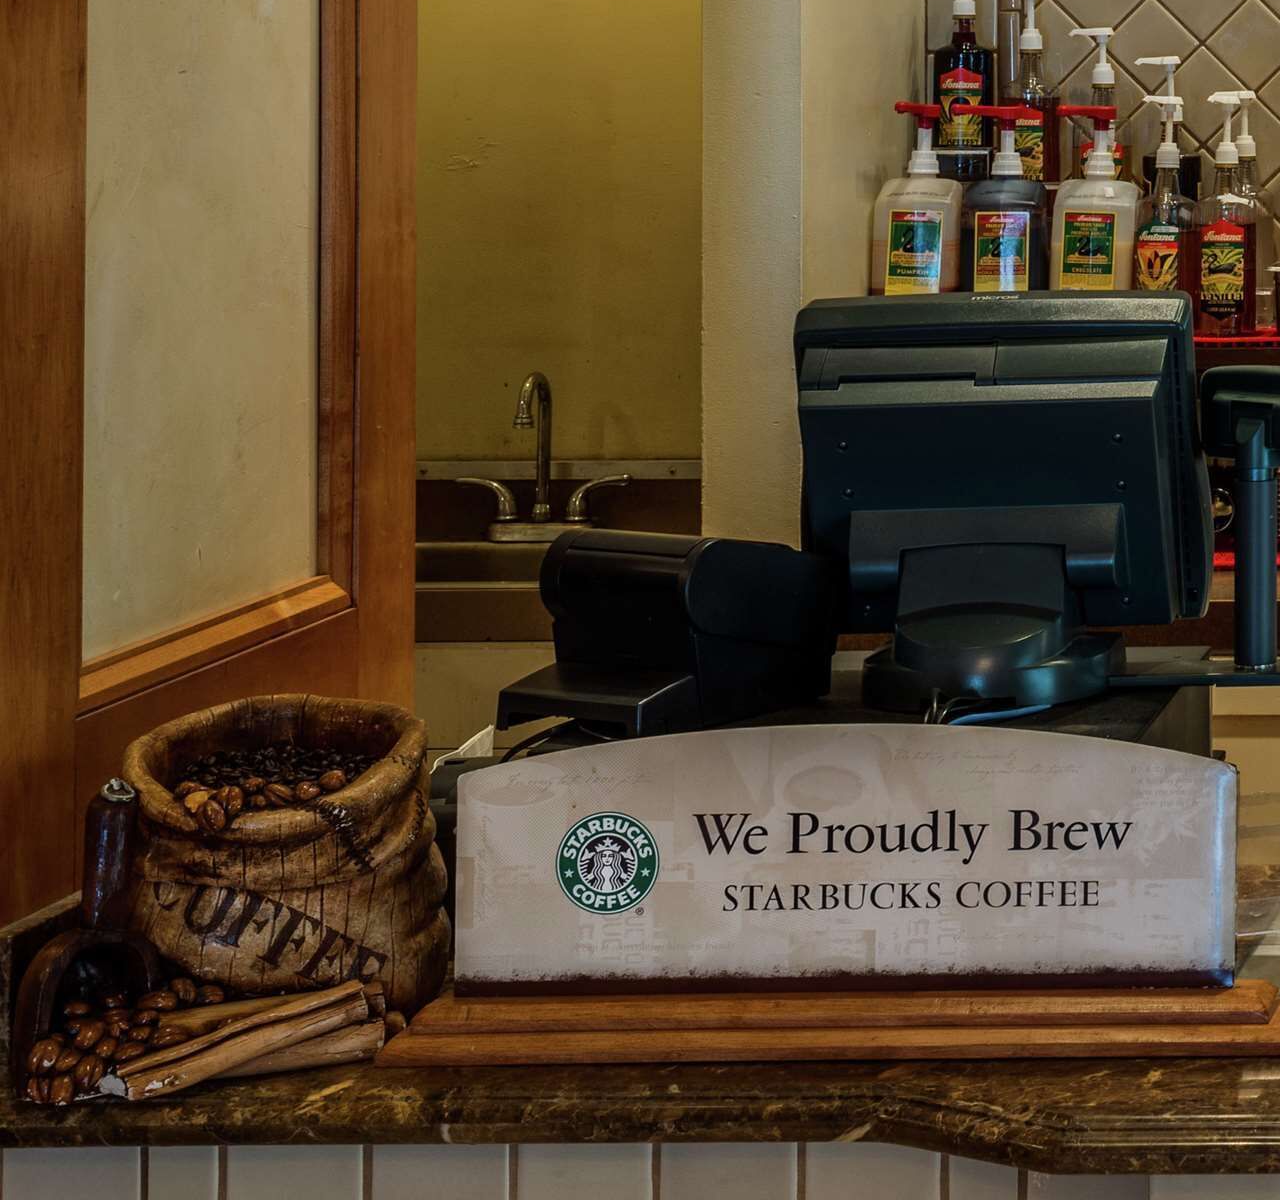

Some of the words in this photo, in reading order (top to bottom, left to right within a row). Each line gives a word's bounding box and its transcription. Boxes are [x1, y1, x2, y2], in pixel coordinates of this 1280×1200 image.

[563, 817, 653, 860] STARBUCKS
[692, 812, 769, 856] We
[785, 809, 990, 865] Proudly
[1007, 809, 1134, 852] Brew
[572, 884, 641, 909] COFFEE
[722, 881, 941, 912] STARBUCKS
[955, 880, 1099, 910] COFFEE
